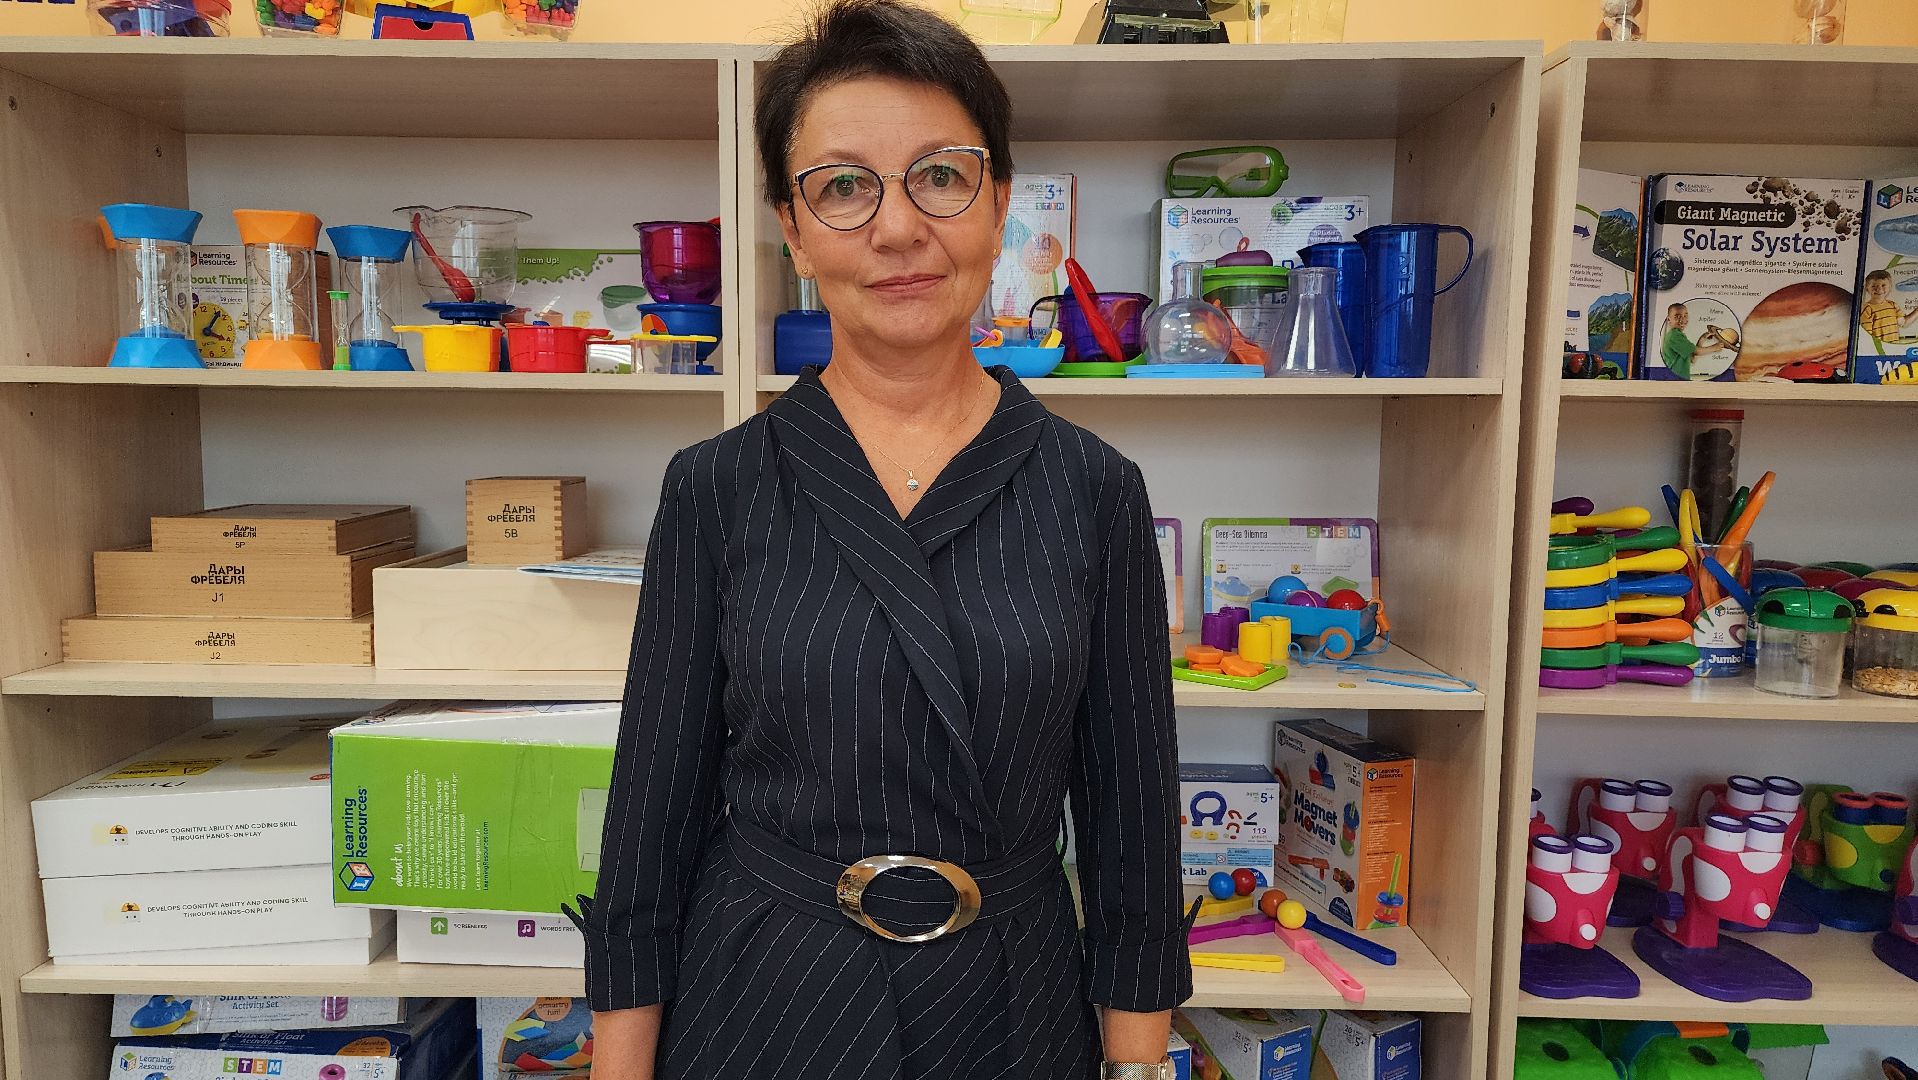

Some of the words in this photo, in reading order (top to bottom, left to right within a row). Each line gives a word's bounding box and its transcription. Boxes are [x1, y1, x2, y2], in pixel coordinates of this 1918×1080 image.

[1045, 184, 1064, 200] 3+
[1191, 207, 1231, 217] Learning
[1344, 204, 1364, 221] 3+
[1677, 205, 1716, 220] Giant
[1718, 208, 1786, 224] Magnetic
[1682, 229, 1743, 252] Solar
[1751, 231, 1839, 259] System
[199, 251, 231, 260] Learning
[199, 259, 238, 267] Resources
[522, 257, 545, 265] Them
[546, 257, 561, 266] Up!
[1733, 259, 1763, 268] magnético
[1687, 266, 1720, 274] magnétique
[1308, 526, 1361, 539] STEM
[211, 592, 225, 603] J1
[210, 651, 222, 660] J2
[1709, 655, 1742, 665] Jumbo
[1260, 792, 1275, 804] 5+
[1293, 789, 1338, 828] Magnet
[135, 828, 169, 836] DEVELOPS
[170, 826, 208, 835] COGNITIVE
[209, 824, 234, 832] ABILITY
[235, 823, 251, 831] AND
[252, 821, 279, 829] CODING
[280, 820, 298, 828] SKILL
[342, 798, 357, 858] Learning
[355, 788, 369, 858] Resources
[1293, 807, 1336, 846] Movers
[171, 833, 205, 842] THROUGH
[206, 831, 244, 840] HANDS-ON
[244, 830, 263, 838] PLAY
[450, 814, 459, 849] educational
[1252, 827, 1267, 835] 119
[394, 842, 404, 854] us
[460, 843, 466, 852] on
[436, 856, 443, 865] 30
[482, 821, 490, 891] LearningResources.com
[413, 857, 421, 870] why
[451, 864, 458, 872] to
[390, 857, 404, 887] about
[1189, 868, 1207, 877] Lab
[406, 877, 413, 887] We
[460, 873, 468, 890] ready
[147, 905, 181, 913] DEVELOPS
[182, 903, 219, 911] COGNITIVE
[220, 901, 245, 909] ABILITY
[246, 900, 261, 908] AND
[262, 899, 290, 907] CODING
[291, 897, 309, 905] SKILL
[183, 910, 216, 919] THROUGH
[217, 908, 255, 917] HANDS-ON
[256, 906, 274, 914] PLAY
[232, 1001, 264, 1010] Activity
[266, 1000, 280, 1009] Set
[241, 1038, 272, 1046] Activity
[275, 1032, 306, 1041] Float
[1355, 1036, 1365, 1047] 5+
[139, 1056, 172, 1064] Learning
[137, 1063, 175, 1071] Resources
[225, 1058, 281, 1075] STEM
[373, 1068, 385, 1079] 5+
